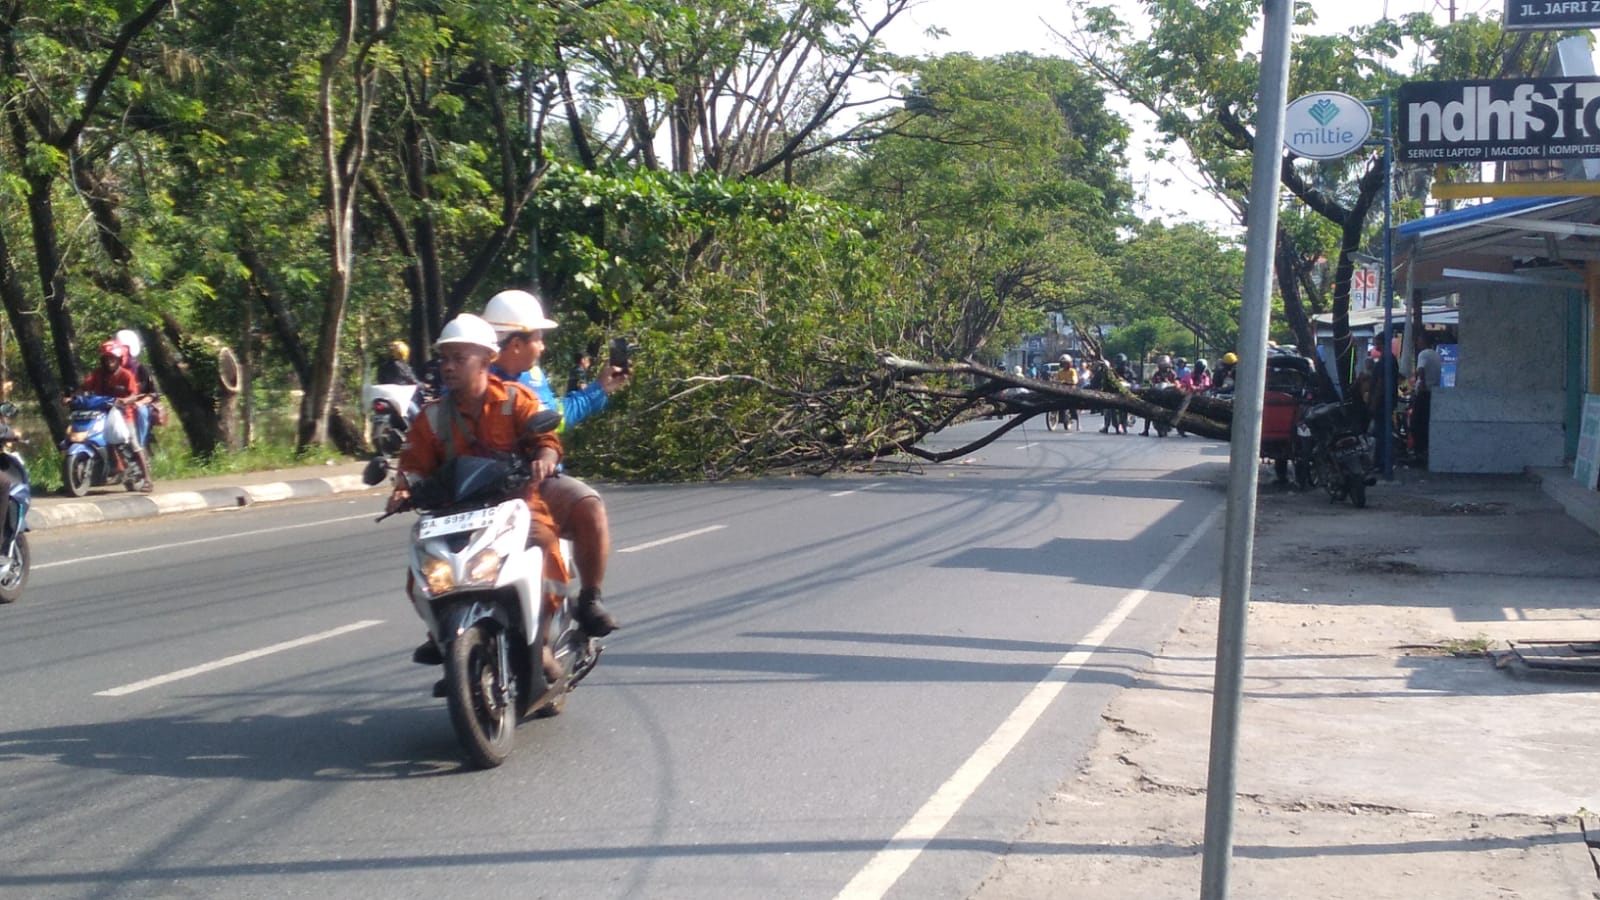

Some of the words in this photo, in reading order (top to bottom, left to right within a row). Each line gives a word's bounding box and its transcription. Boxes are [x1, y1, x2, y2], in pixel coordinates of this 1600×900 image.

[1520, 4, 1540, 16] JL.
[1544, 2, 1588, 15] JAFRI
[1293, 128, 1353, 145] miltie
[1408, 149, 1445, 158] SERVICE
[1446, 147, 1481, 157] LAPTOP
[1491, 145, 1540, 156] MACBOOK
[1549, 143, 1600, 154] KOMPUTER
